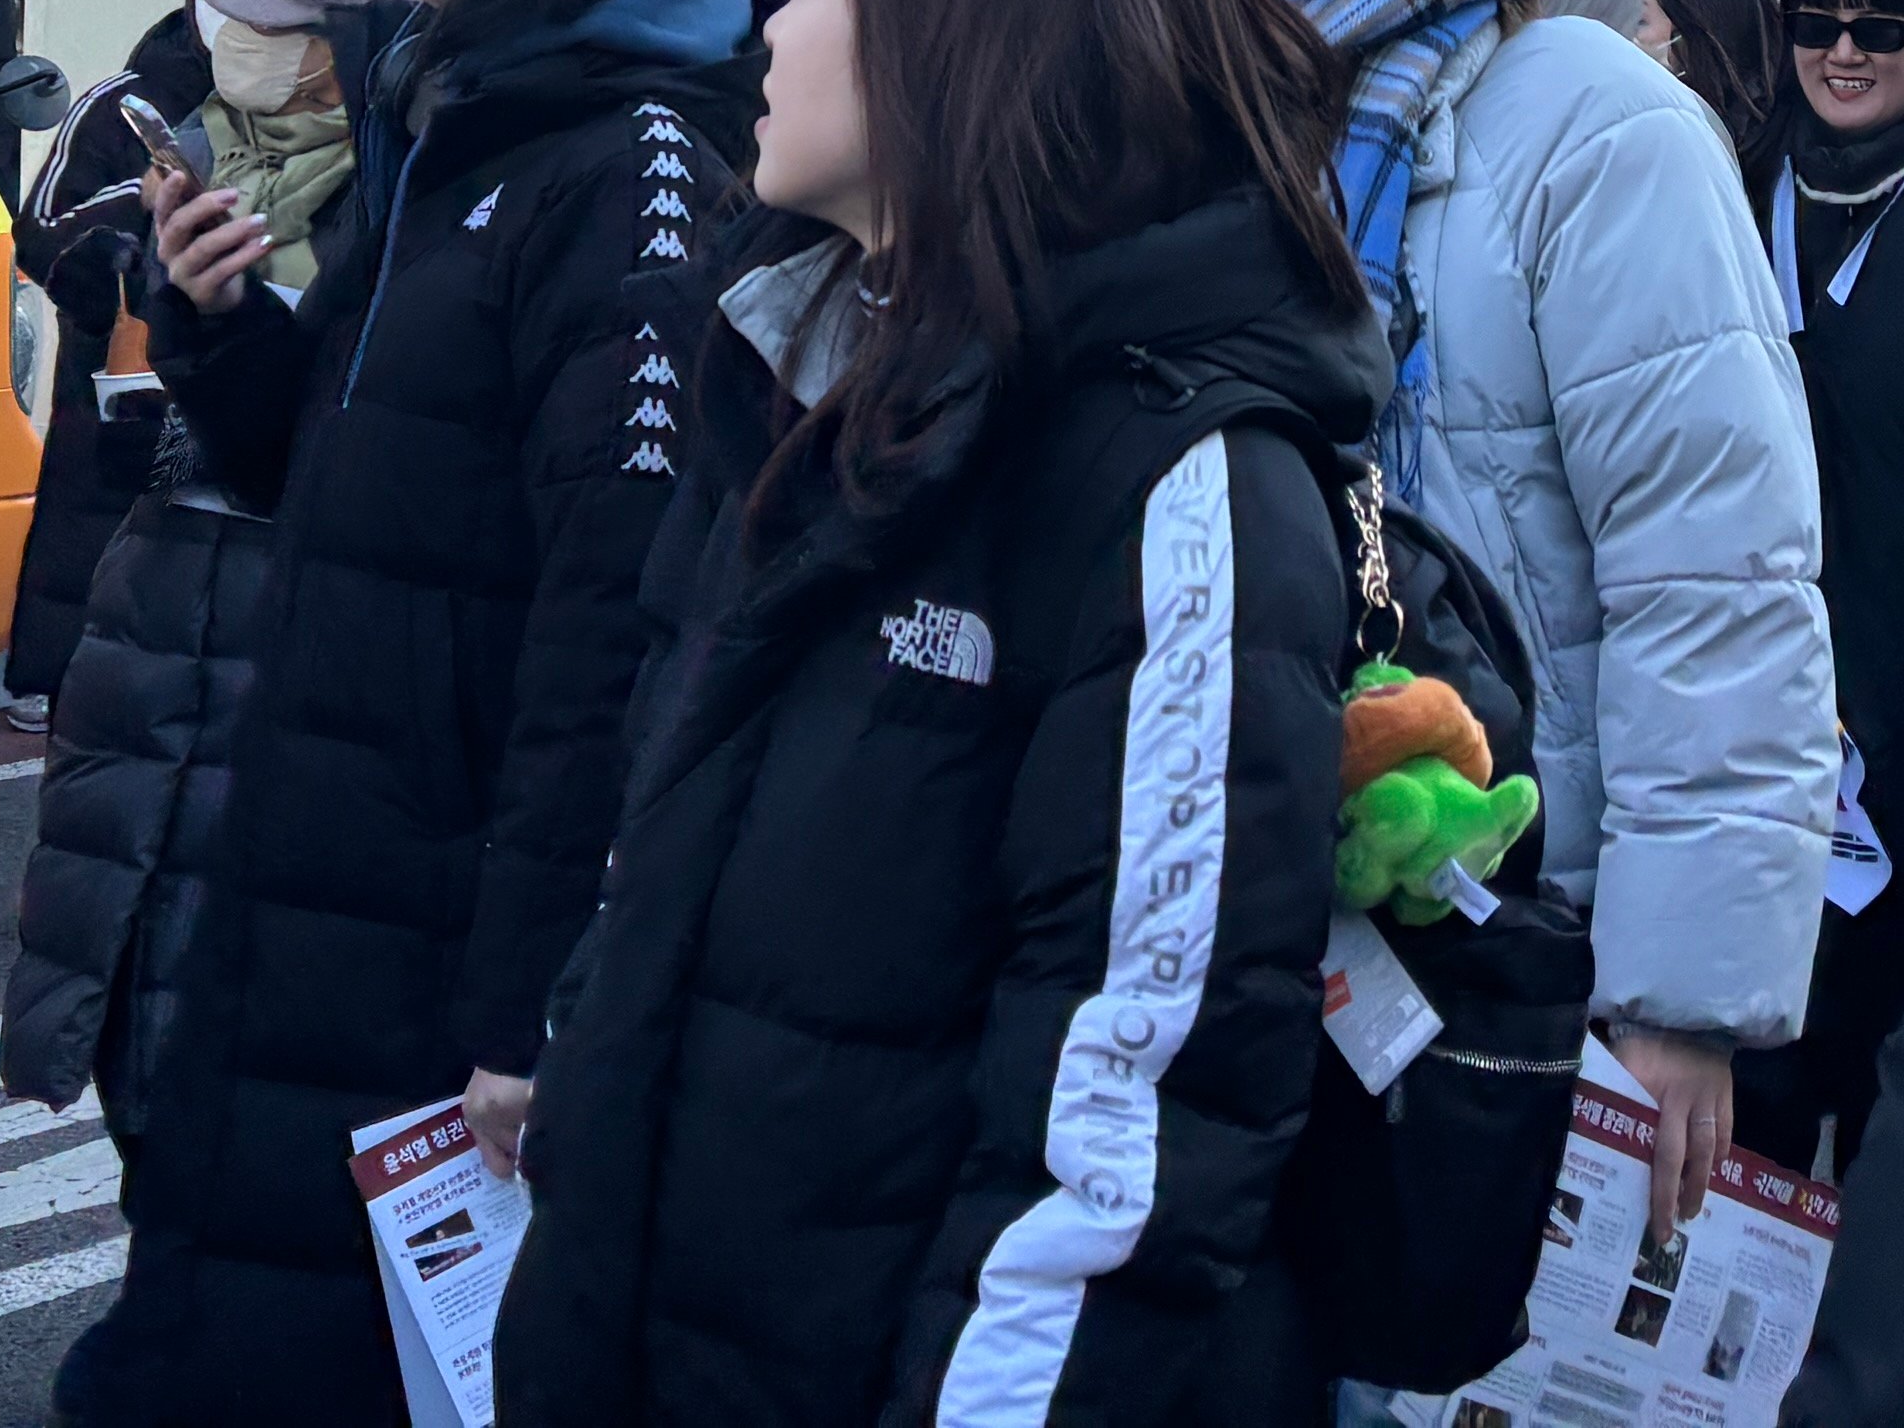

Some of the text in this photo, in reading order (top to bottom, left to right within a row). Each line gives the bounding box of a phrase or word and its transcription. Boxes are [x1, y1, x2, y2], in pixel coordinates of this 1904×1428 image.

[1164, 454, 1212, 624] EVER
[914, 598, 962, 633] THE
[880, 615, 956, 657] NORTH
[888, 639, 951, 675] FACE
[430, 1117, 467, 1149] 정권
